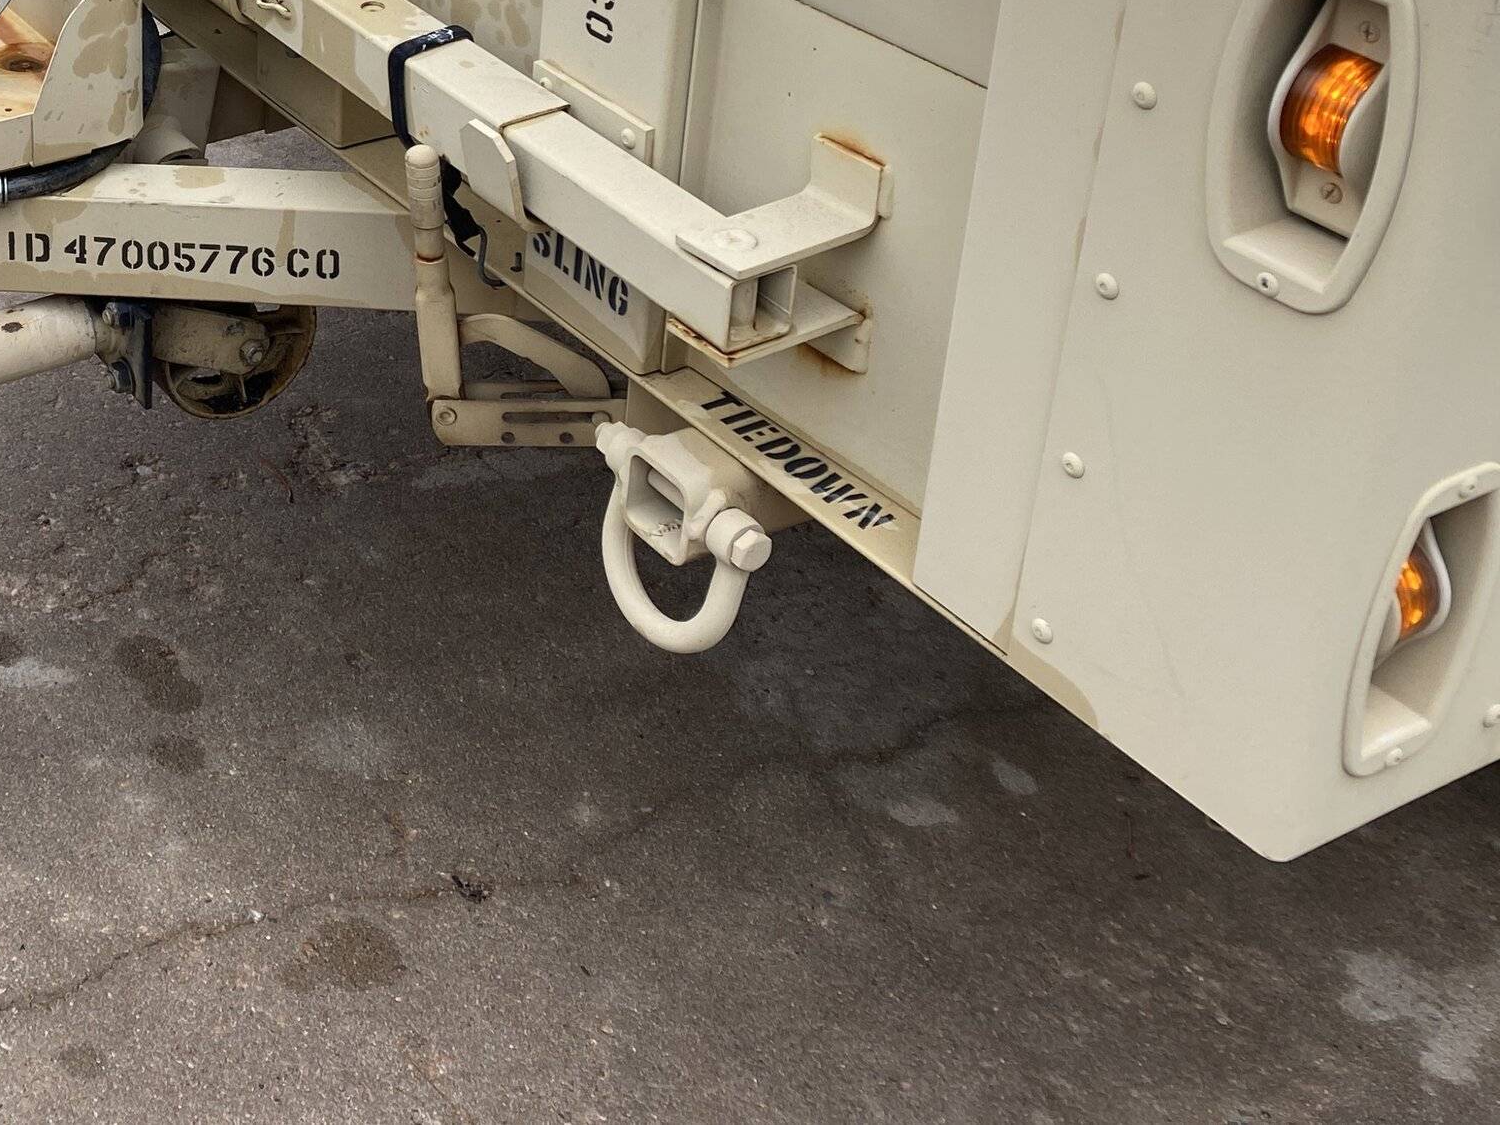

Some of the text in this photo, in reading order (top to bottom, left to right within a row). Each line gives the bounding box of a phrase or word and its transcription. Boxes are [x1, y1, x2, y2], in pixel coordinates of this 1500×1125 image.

[7, 231, 50, 263] ID
[63, 235, 276, 277] 47005776
[532, 230, 629, 316] SLING
[700, 389, 896, 530] TIEDOWN
